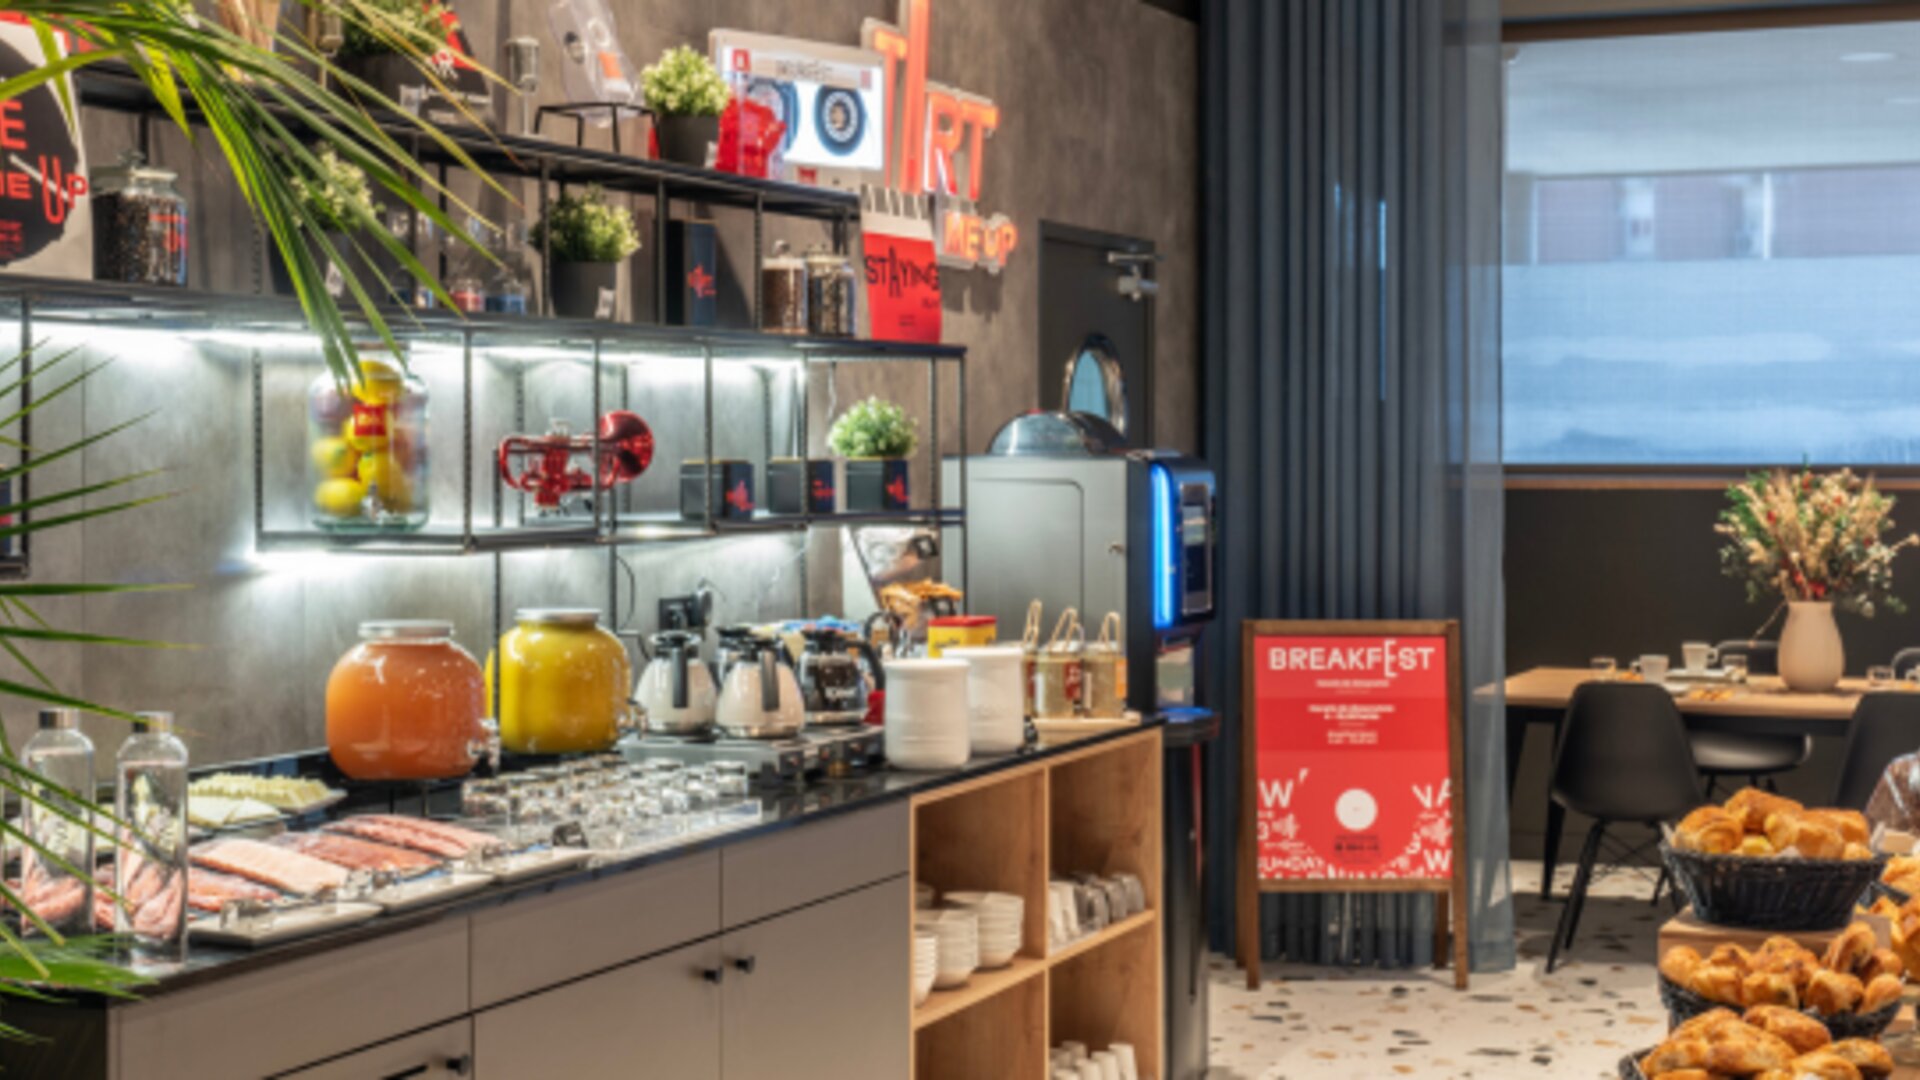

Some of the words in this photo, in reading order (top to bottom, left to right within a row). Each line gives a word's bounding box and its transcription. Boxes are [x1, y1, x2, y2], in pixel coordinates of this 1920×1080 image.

[38, 155, 88, 224] UP
[943, 211, 981, 260] ME
[984, 222, 1017, 267] UP
[864, 245, 939, 298] STAYING
[1269, 639, 1435, 678] BREAKFEST
